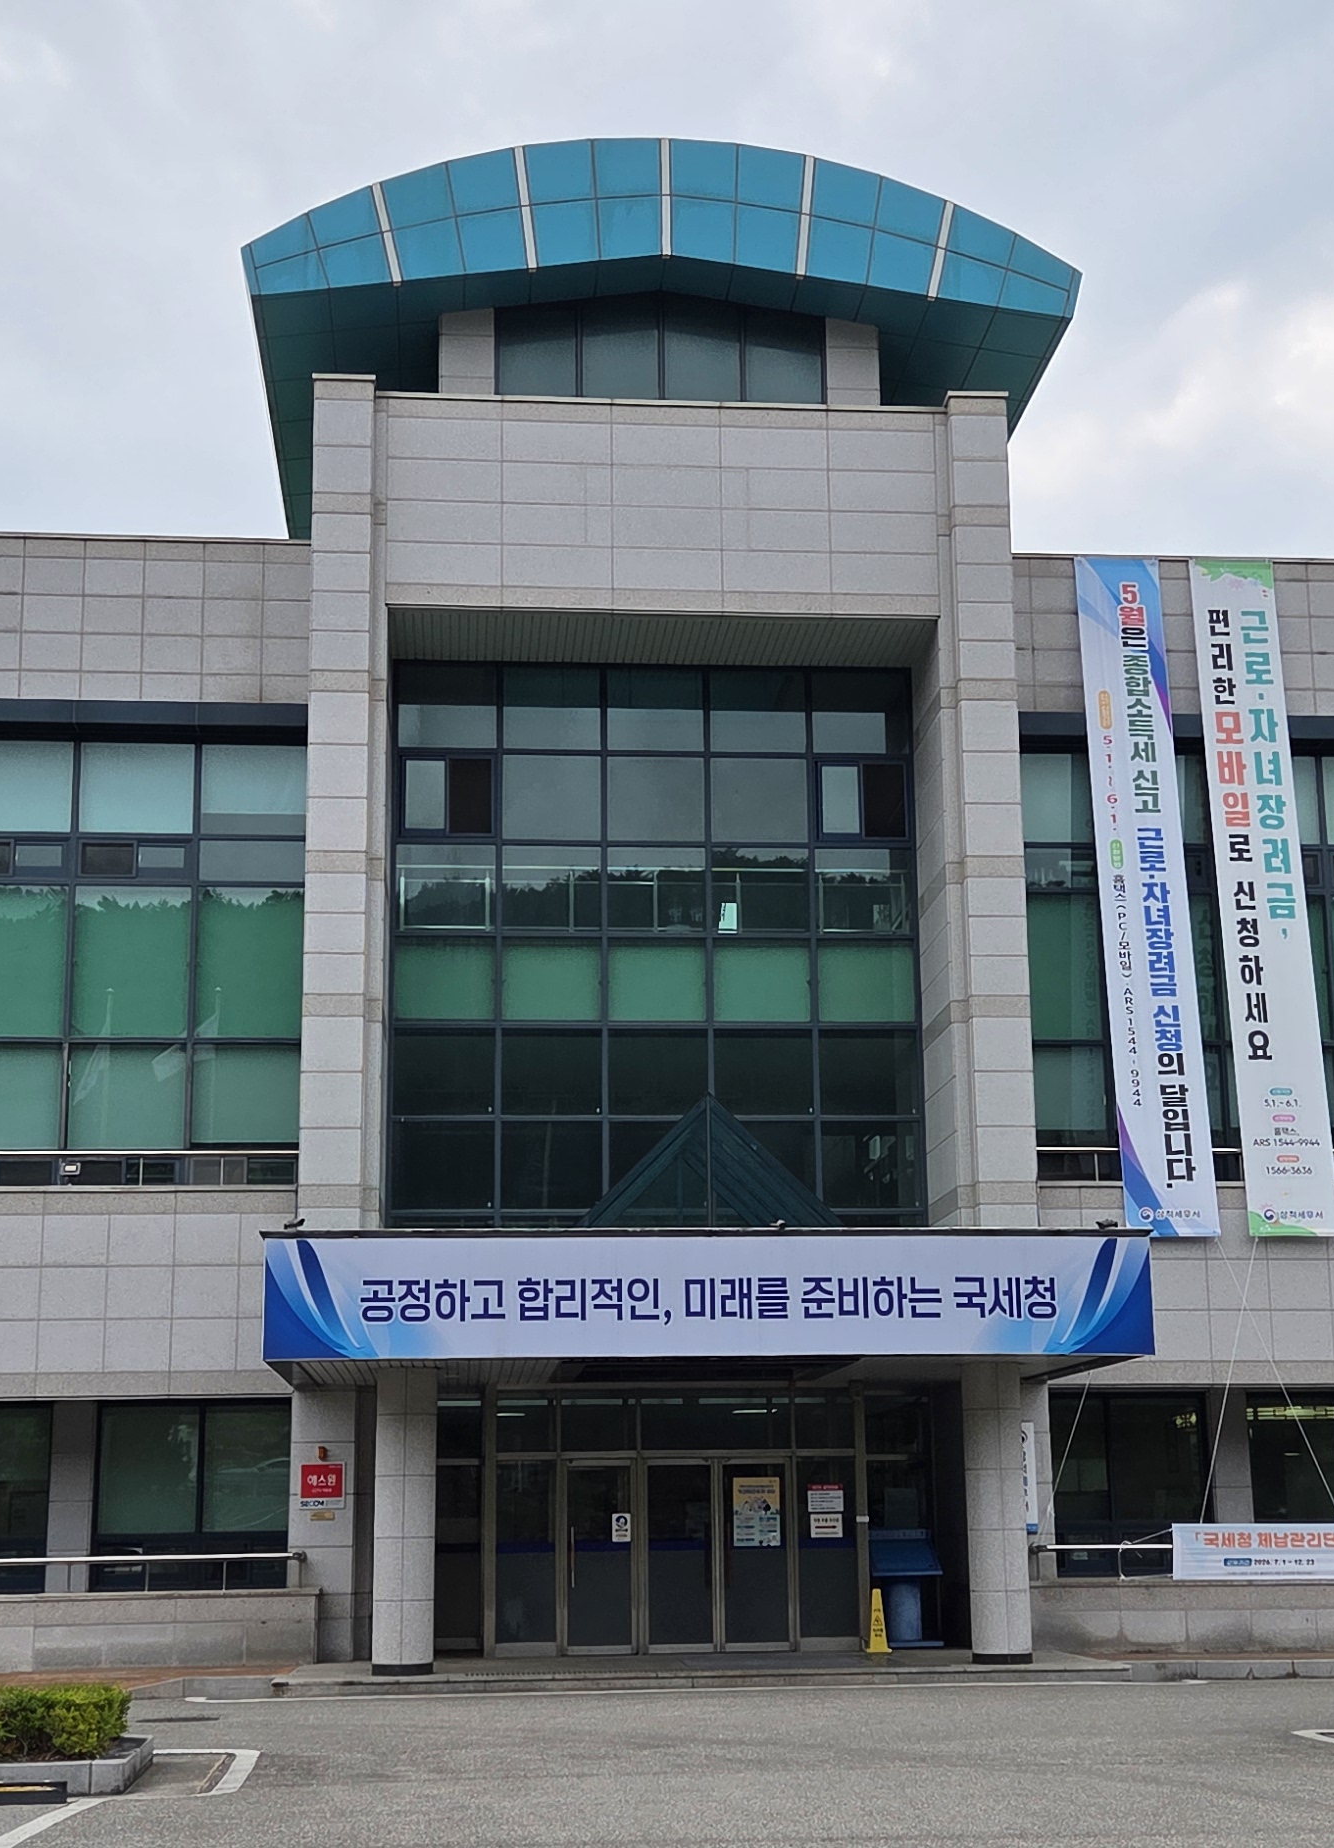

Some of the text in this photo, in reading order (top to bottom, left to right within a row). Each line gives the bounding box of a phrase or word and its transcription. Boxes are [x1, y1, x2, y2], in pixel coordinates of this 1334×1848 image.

[1240, 609, 1297, 941] 근로·자녀장려금,
[1207, 608, 1274, 1062] 편리한 모바일로 신청하세요
[1119, 583, 1197, 1190] 5월은 종합소득세 신고 근로·자녀장려금 신청의 달입니다.
[1252, 1138, 1321, 1147] ARS 1544-9944
[1265, 1166, 1313, 1176] 1566-3636
[1155, 1209, 1201, 1220] 삼척세무서
[1279, 1209, 1324, 1220] 삼척세무서
[359, 1275, 1059, 1326] 공정하고 합리적인, 미래를 준비하는 국세청
